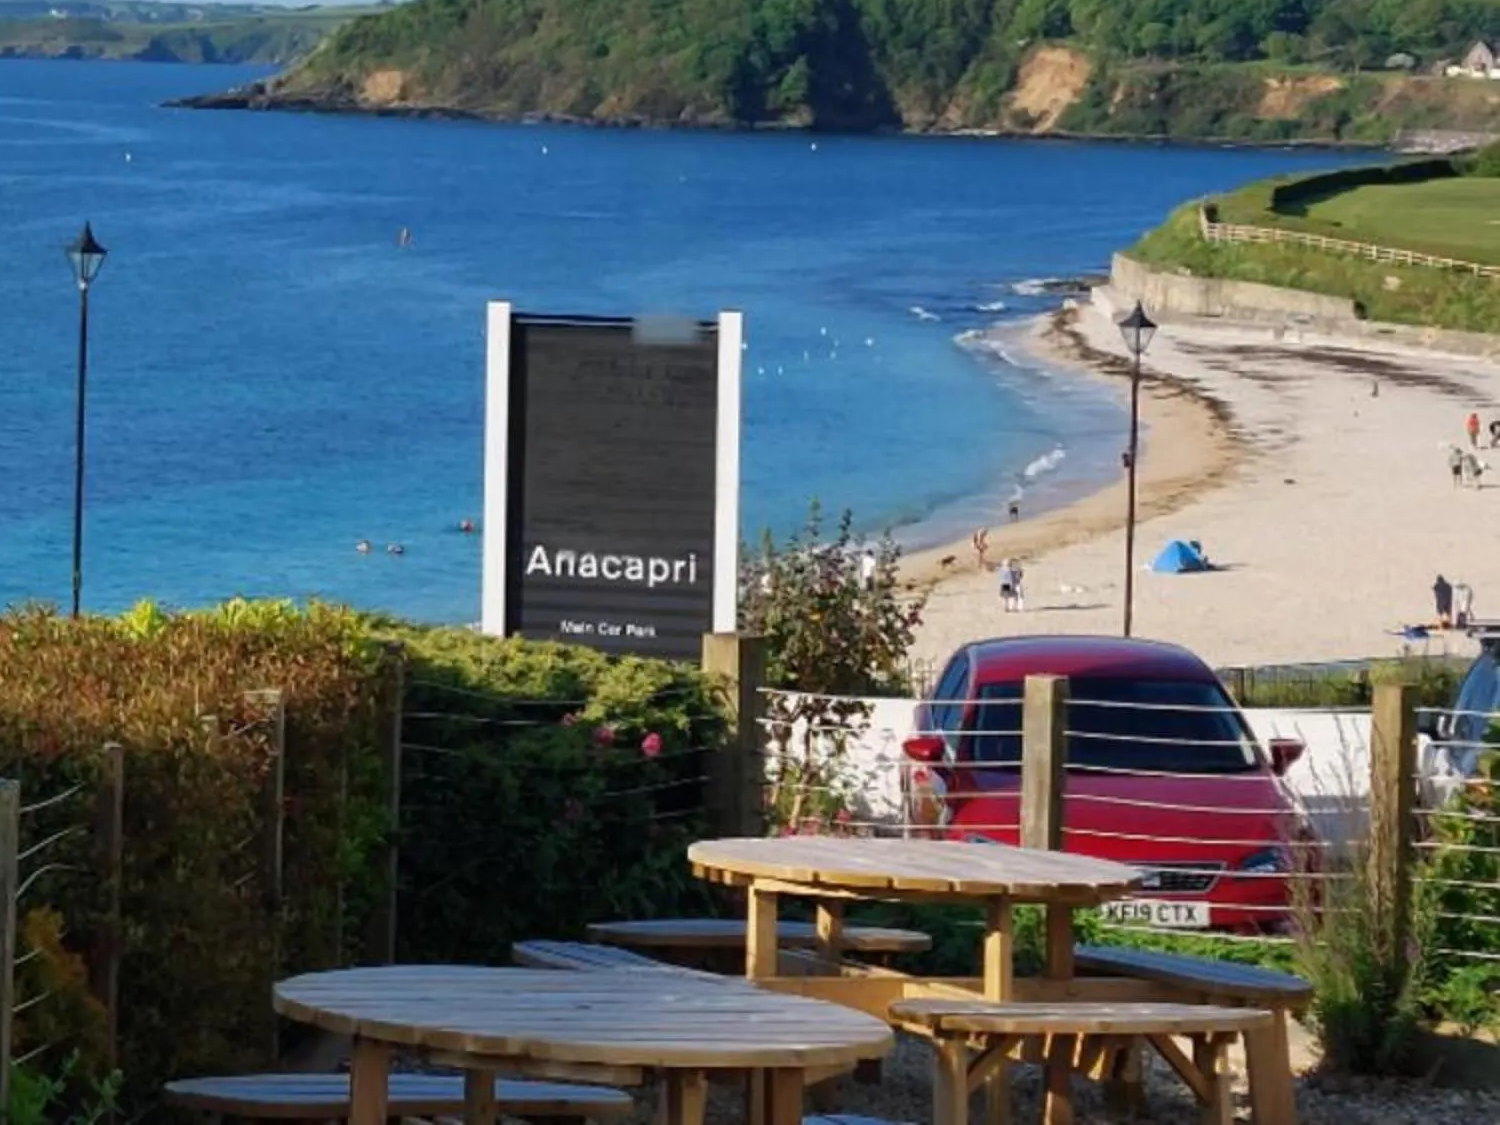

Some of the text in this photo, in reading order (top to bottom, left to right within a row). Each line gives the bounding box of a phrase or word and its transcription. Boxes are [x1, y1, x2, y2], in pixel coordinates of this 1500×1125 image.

[526, 545, 697, 588] Anacapri
[560, 619, 656, 638] Main Car Park
[1156, 903, 1198, 923] CTX
